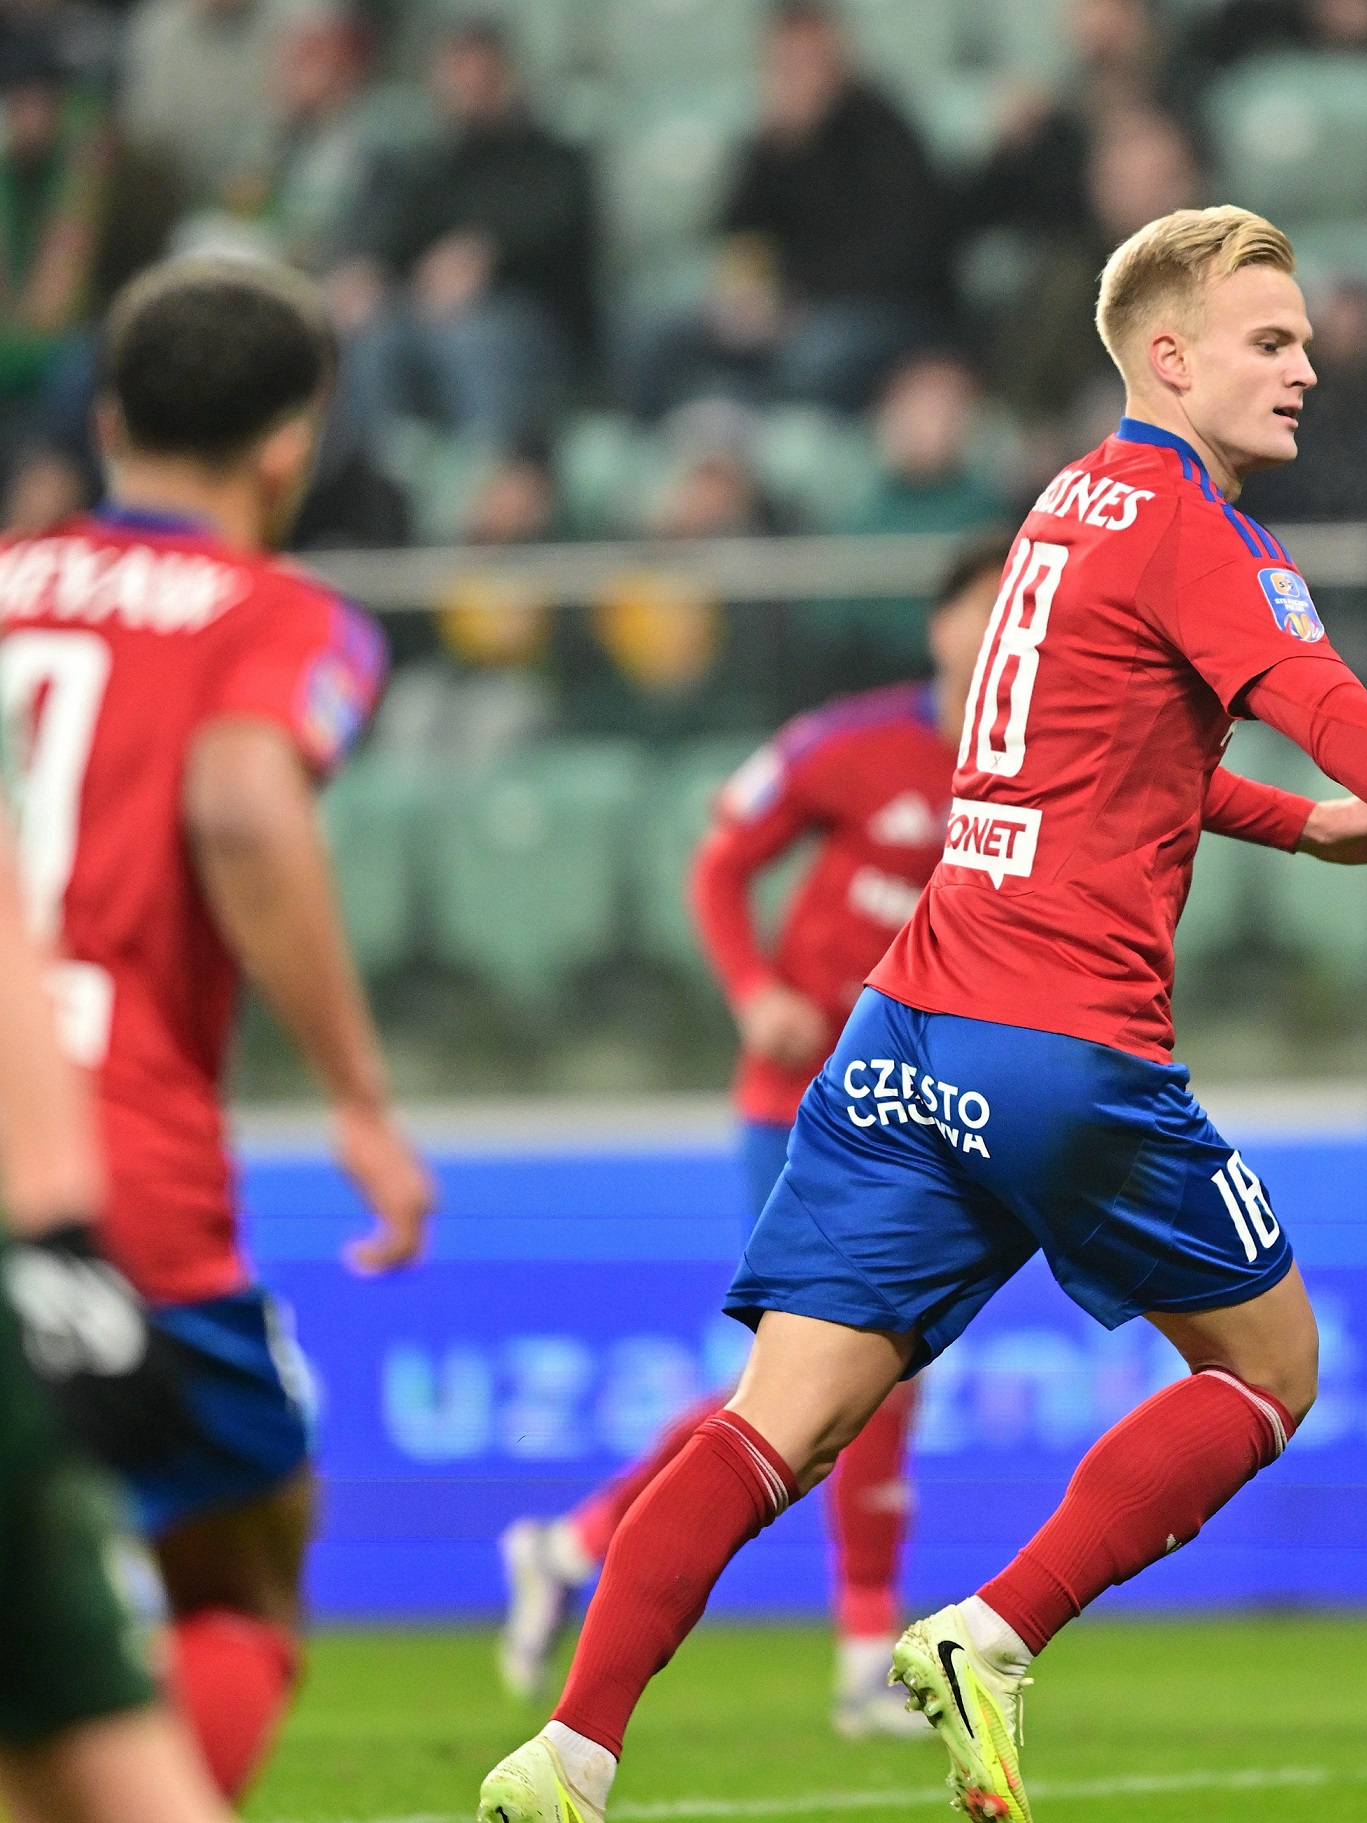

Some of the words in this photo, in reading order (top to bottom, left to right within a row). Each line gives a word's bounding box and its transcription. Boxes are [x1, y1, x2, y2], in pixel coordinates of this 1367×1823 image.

[957, 537, 1069, 778] 18
[945, 813, 1027, 860] ONET
[1211, 1149, 1280, 1263] 18
